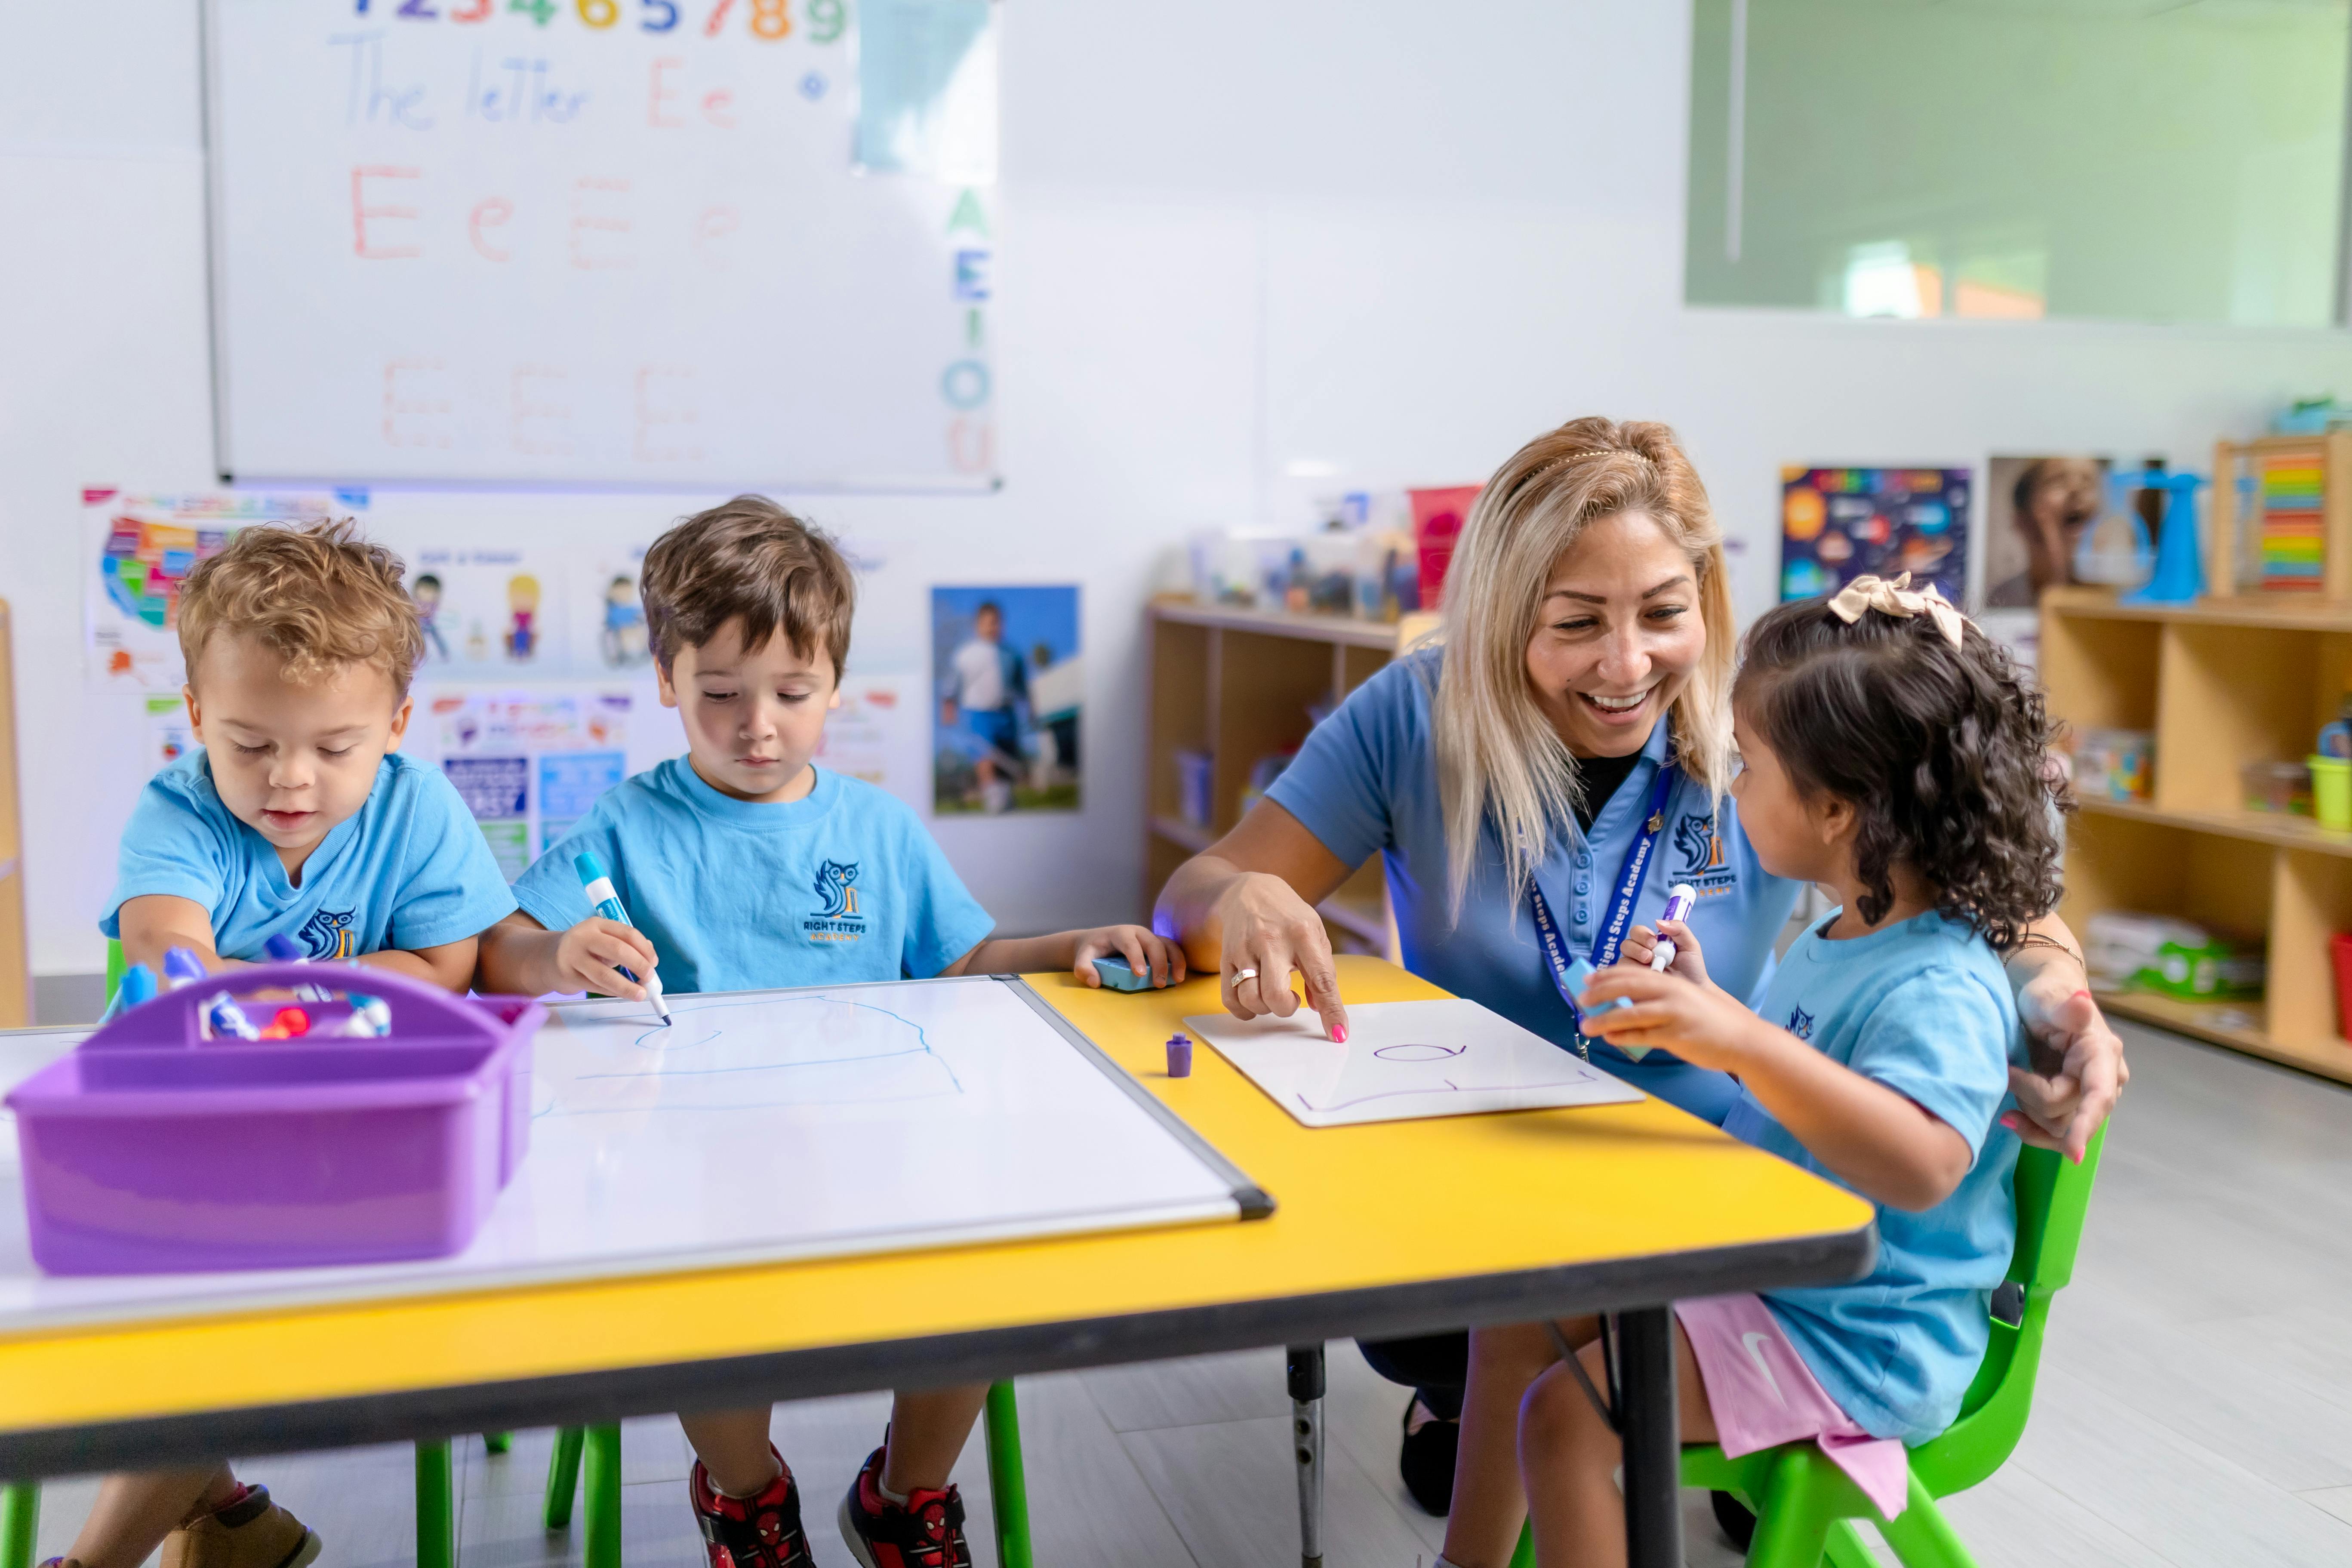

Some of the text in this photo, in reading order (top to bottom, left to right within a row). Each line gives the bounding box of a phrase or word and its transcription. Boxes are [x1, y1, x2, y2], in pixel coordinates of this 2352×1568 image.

[750, 0, 791, 41] 8
[807, 0, 846, 45] 9
[327, 30, 434, 130] The
[351, 166, 422, 259] E
[468, 196, 515, 262] e
[1609, 898, 1629, 935] Steps
[1621, 837, 1650, 897] Academy
[803, 921, 866, 934] RIGHT STEPS
[810, 933, 859, 941] ACADEMY
